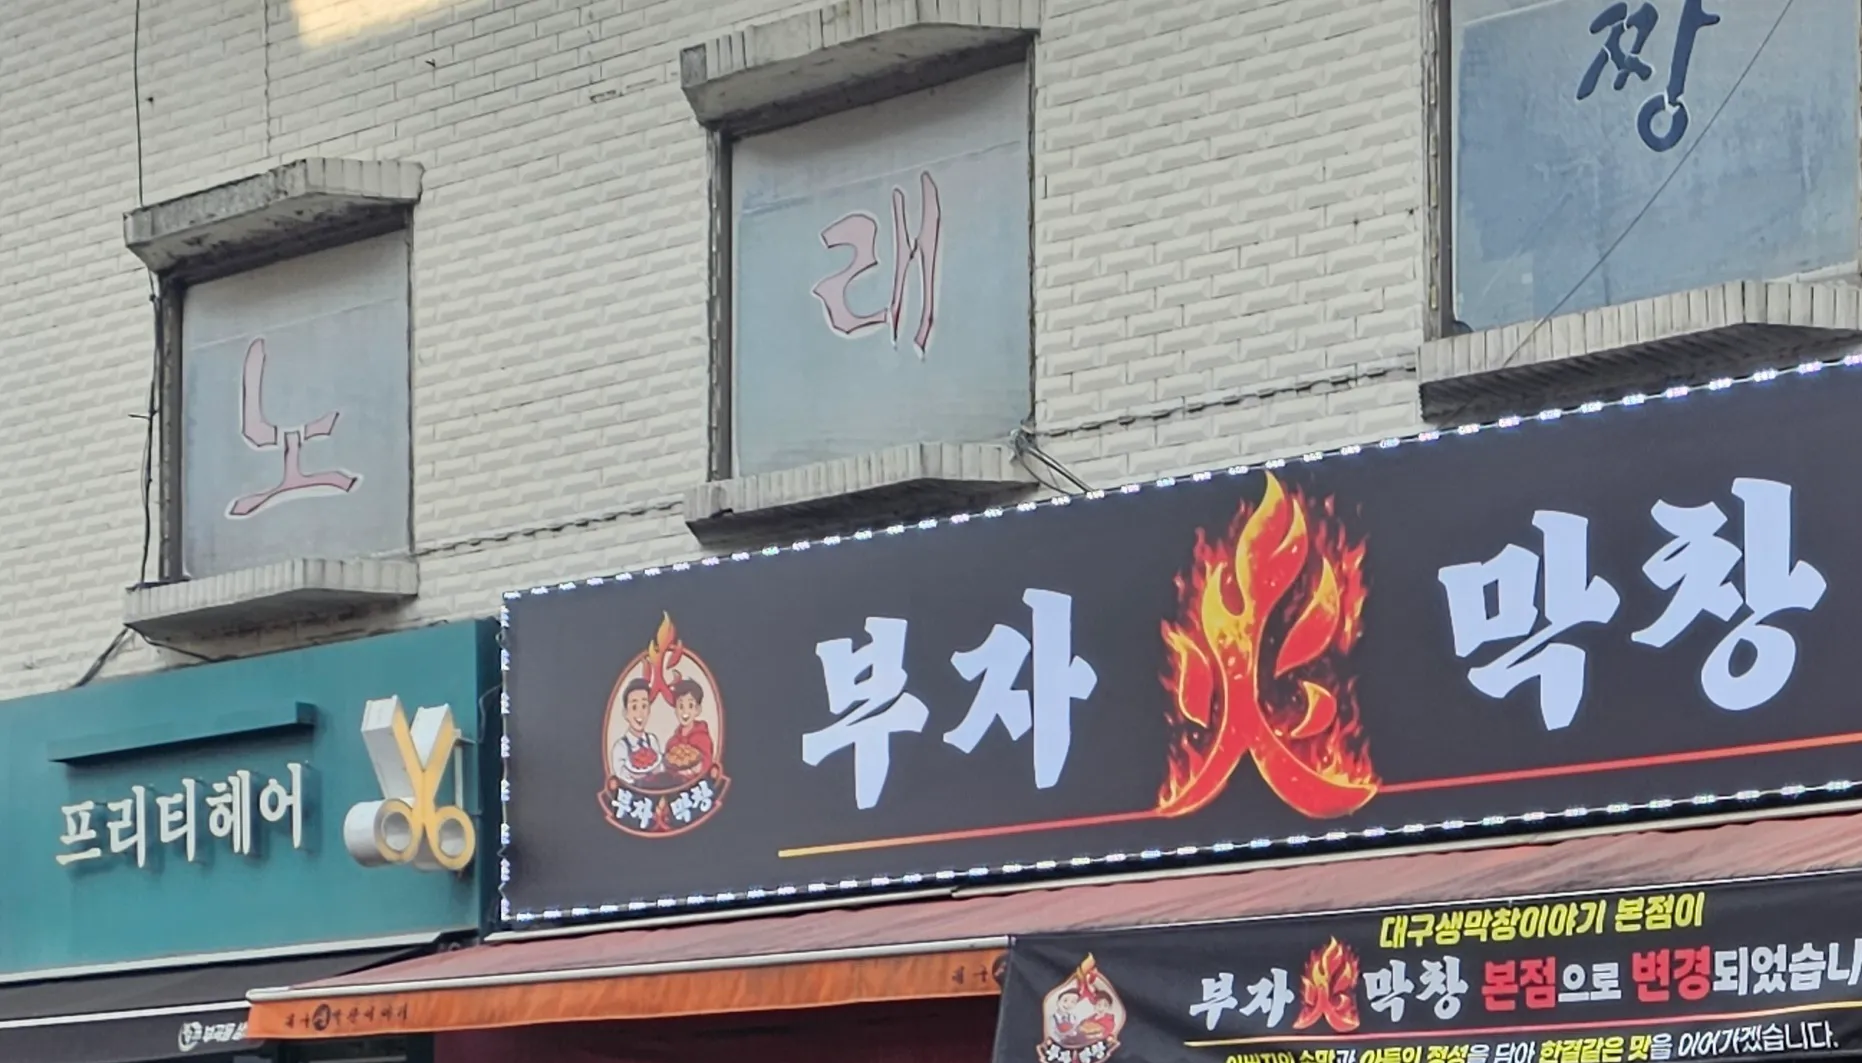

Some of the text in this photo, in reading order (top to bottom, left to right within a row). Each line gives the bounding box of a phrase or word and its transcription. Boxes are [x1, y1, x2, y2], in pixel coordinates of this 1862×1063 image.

[809, 170, 942, 358] 래
[224, 336, 363, 519] 노
[803, 587, 1099, 810] 부자
[1438, 476, 1828, 732] 막창
[54, 760, 305, 869] 프리티헤어
[1379, 890, 1707, 949] 대구생막창이야기 본점이
[1188, 966, 1296, 1032] 부자
[1362, 954, 1470, 1024] 막창
[1481, 955, 1622, 1013] 본점으로
[1628, 1032, 1674, 1063] 맛을
[1677, 1019, 1840, 1058] 이어가겠습니다.
